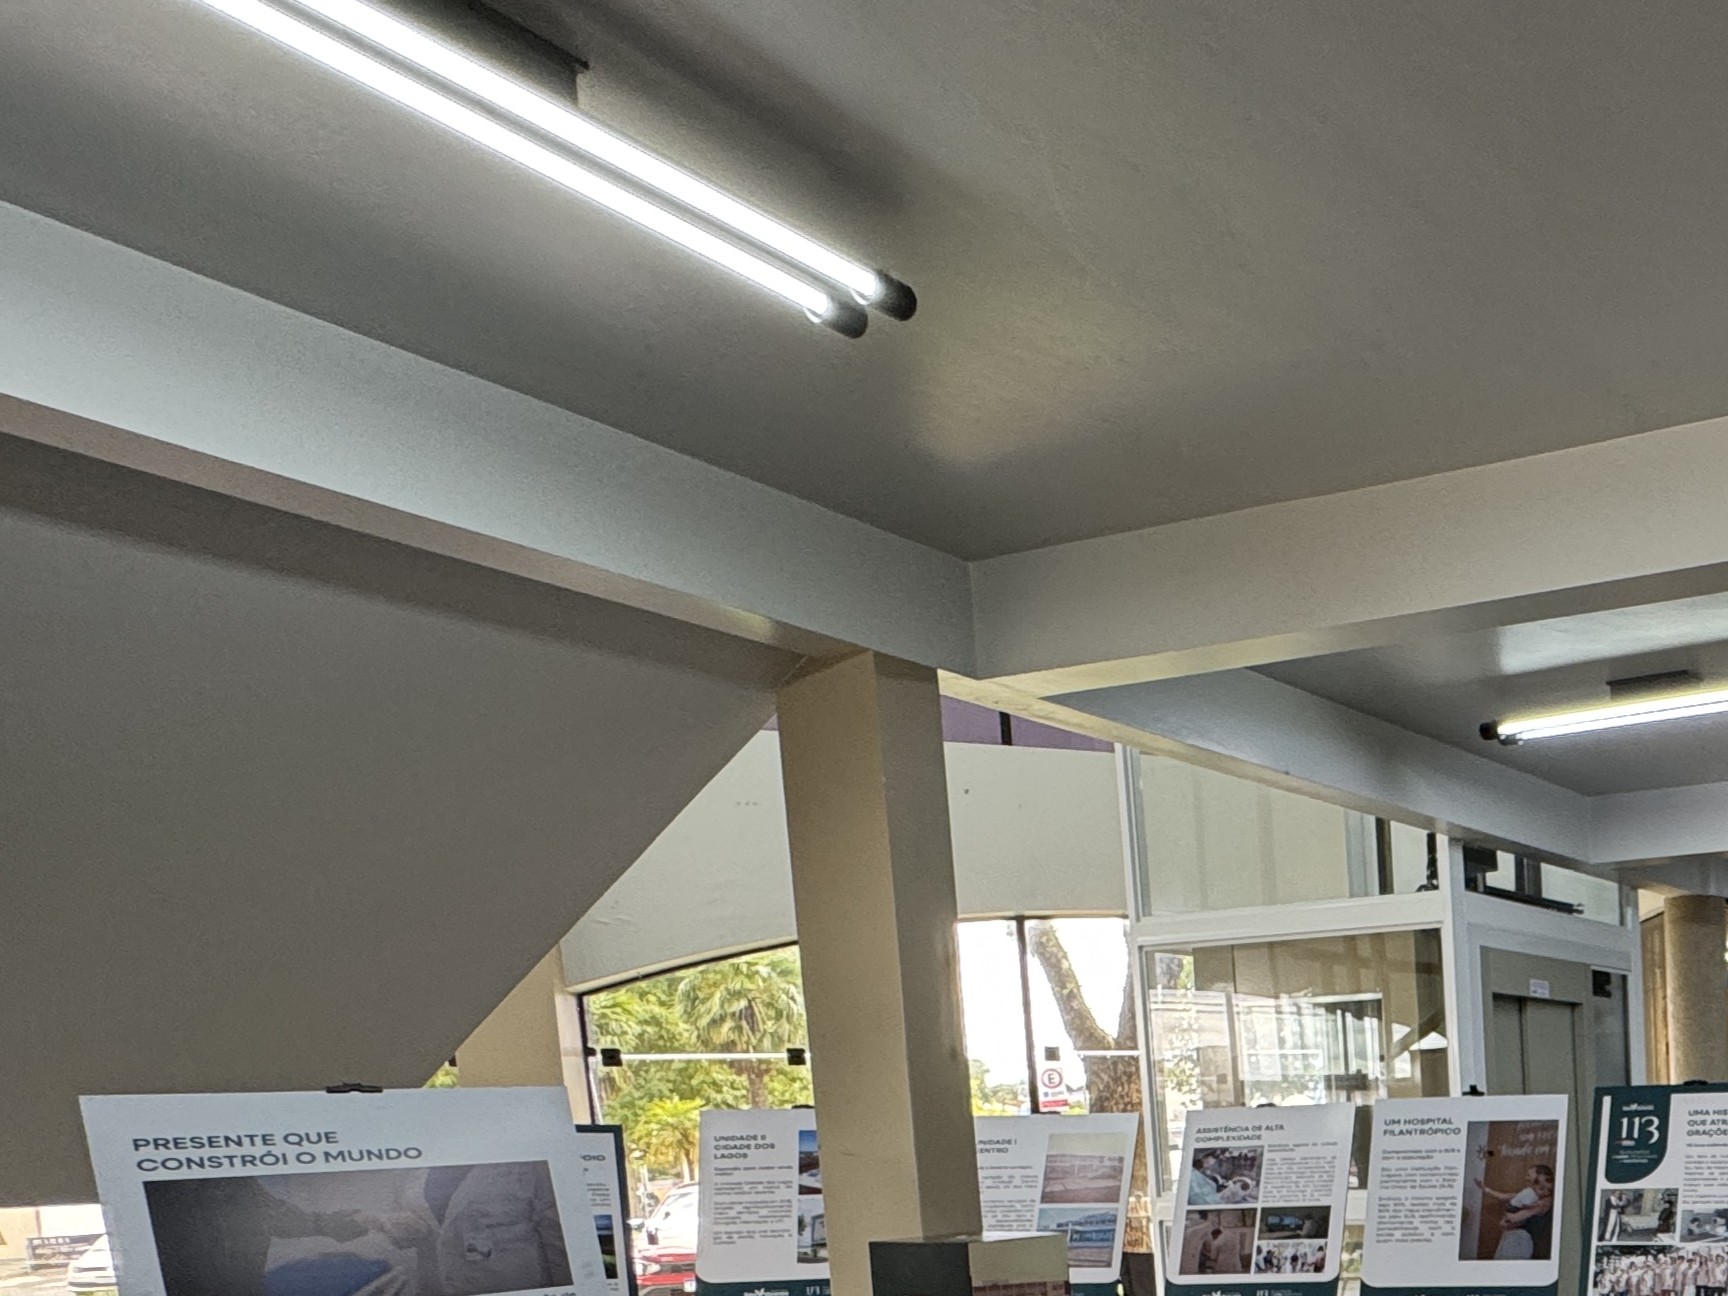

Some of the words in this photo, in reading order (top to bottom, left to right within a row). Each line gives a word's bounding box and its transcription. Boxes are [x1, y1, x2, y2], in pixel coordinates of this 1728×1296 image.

[1048, 1073, 1055, 1084] E
[1688, 1119, 1707, 1127] QUE
[1196, 1125, 1249, 1134] ASSISTÊNCIA
[1383, 1126, 1461, 1136] FILANTRÓPICO
[1620, 1116, 1660, 1144] 113
[132, 1133, 276, 1151] PRESENTE
[283, 1132, 339, 1147] QUE
[1195, 1135, 1262, 1143] COMPLEXIDADE
[136, 1151, 288, 1172] CONSTRÓI
[296, 1151, 316, 1164] O
[324, 1147, 422, 1164] MUNDO
